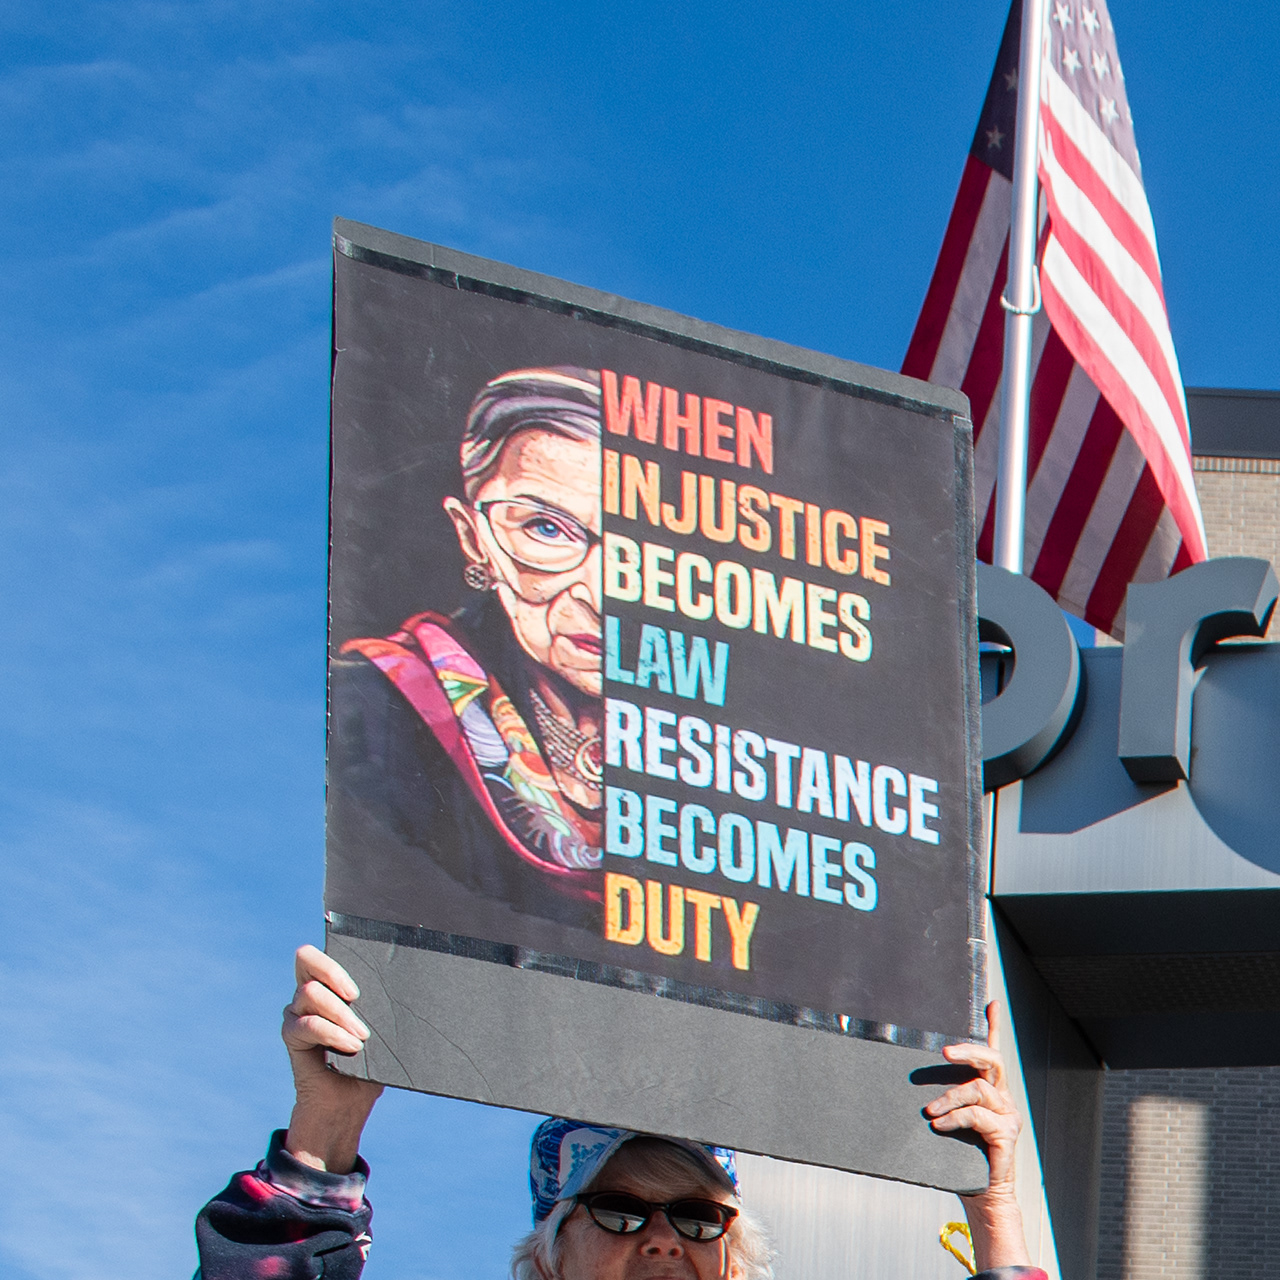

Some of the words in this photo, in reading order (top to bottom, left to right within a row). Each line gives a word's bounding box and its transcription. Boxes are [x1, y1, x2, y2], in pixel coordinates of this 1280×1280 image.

[602, 369, 774, 473] WHEN
[603, 450, 891, 586] INJUSTICE
[604, 541, 873, 664] BECOMES
[605, 618, 729, 706] LAW
[605, 699, 940, 845] RESISTANCE
[605, 789, 877, 912] BECOMES
[605, 874, 760, 971] DUTY
